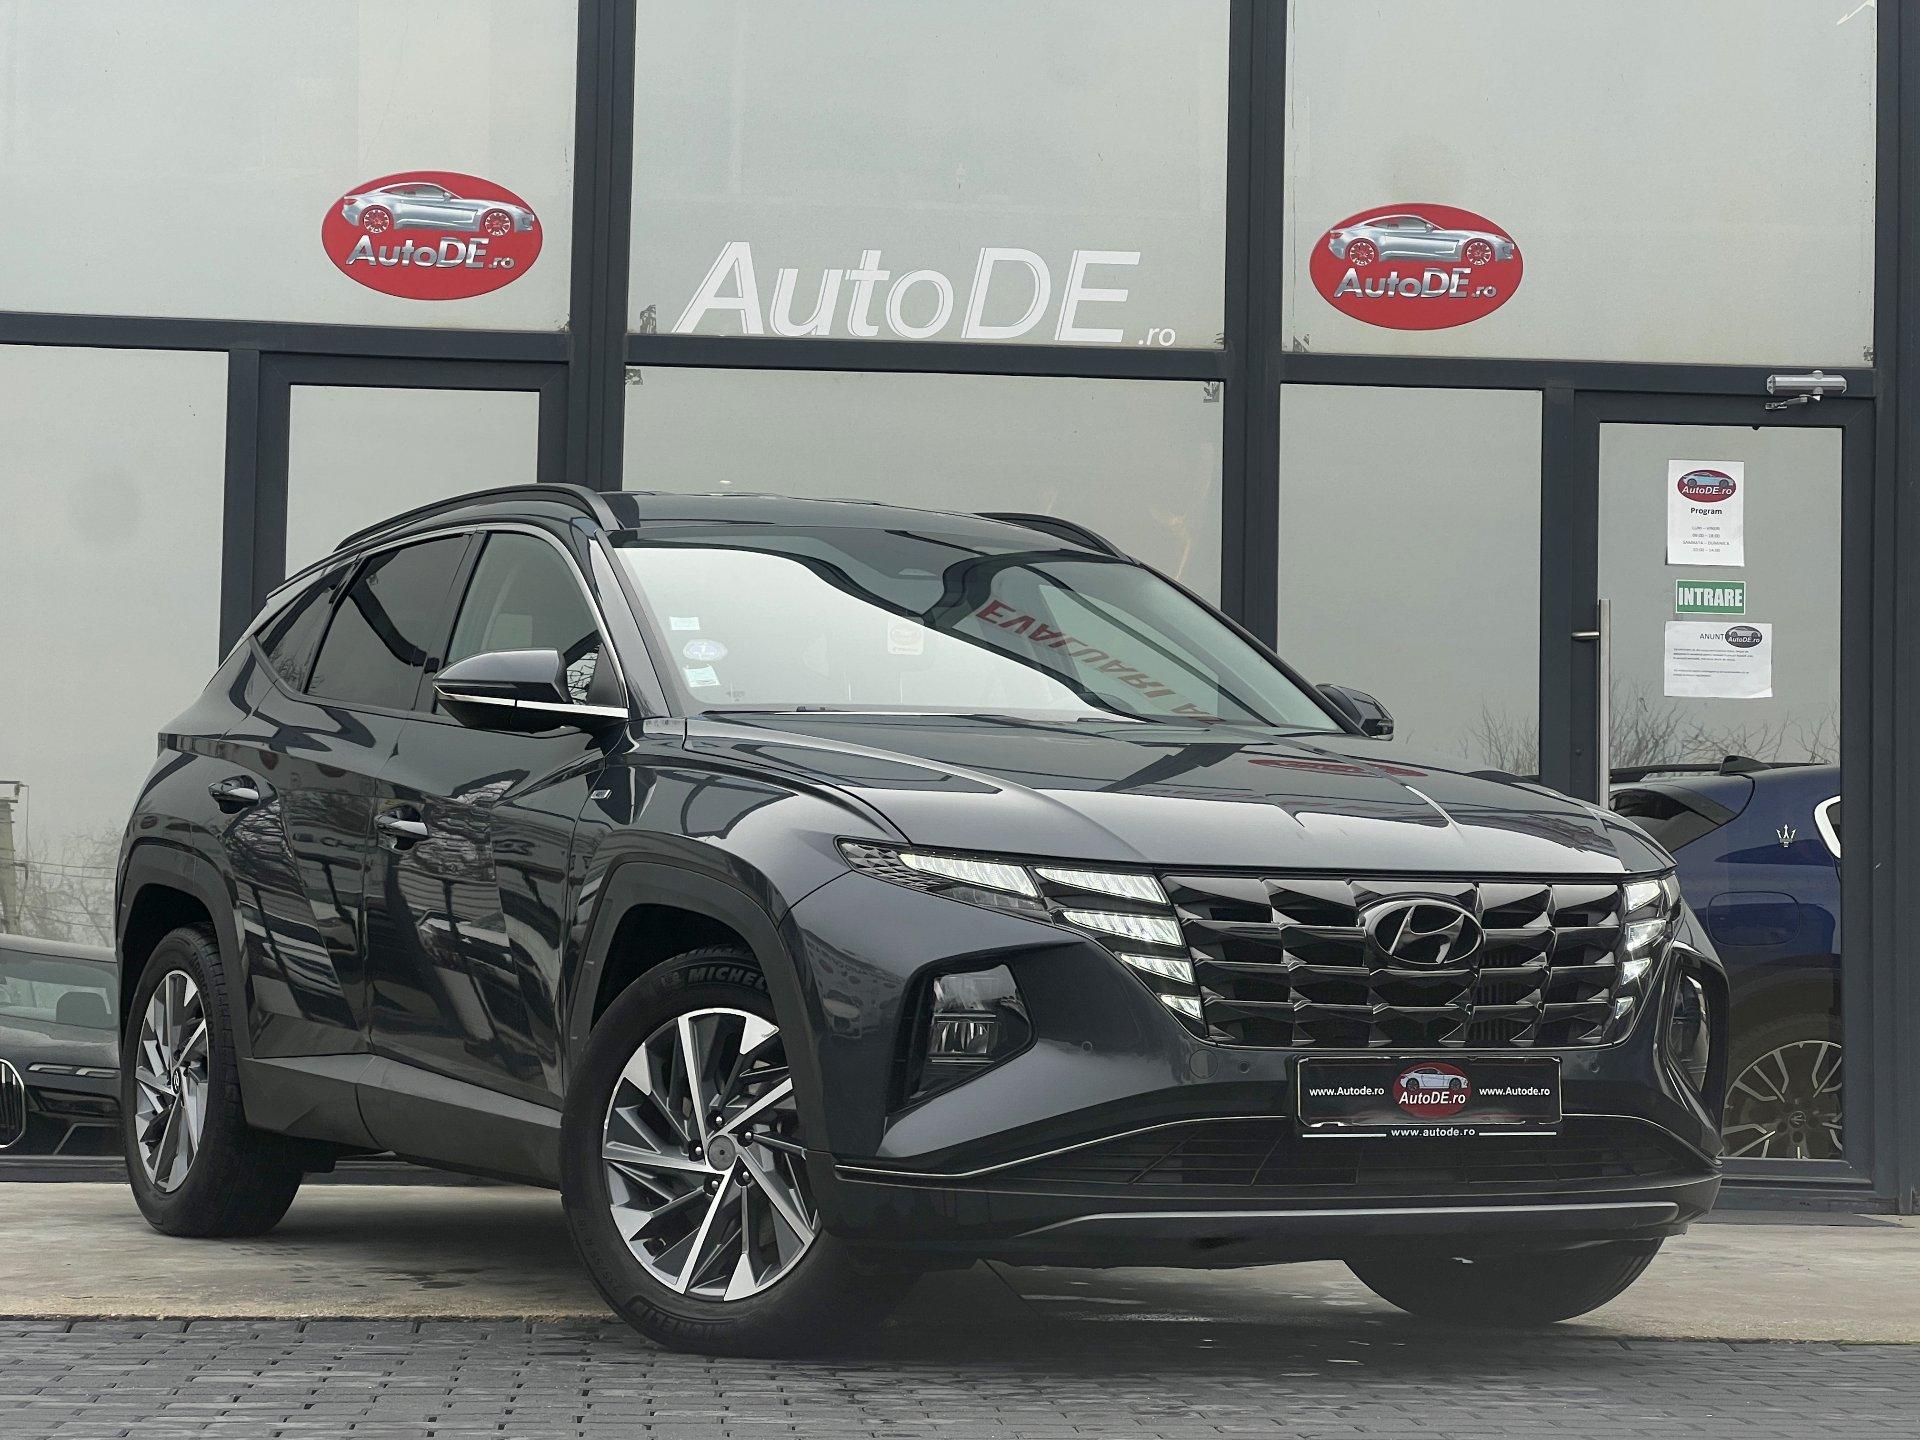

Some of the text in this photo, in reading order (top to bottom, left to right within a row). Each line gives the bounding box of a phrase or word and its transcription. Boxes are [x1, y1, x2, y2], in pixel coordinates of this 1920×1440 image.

[1681, 486, 1732, 495] AutoDE.ro
[1690, 507, 1723, 516] Program
[1678, 587, 1743, 607] INTRARE
[1309, 1085, 1551, 1105] www.Autode.ro AutoDE.ro www.Autode.ro
[1390, 1127, 1476, 1137] www.autode.ro
